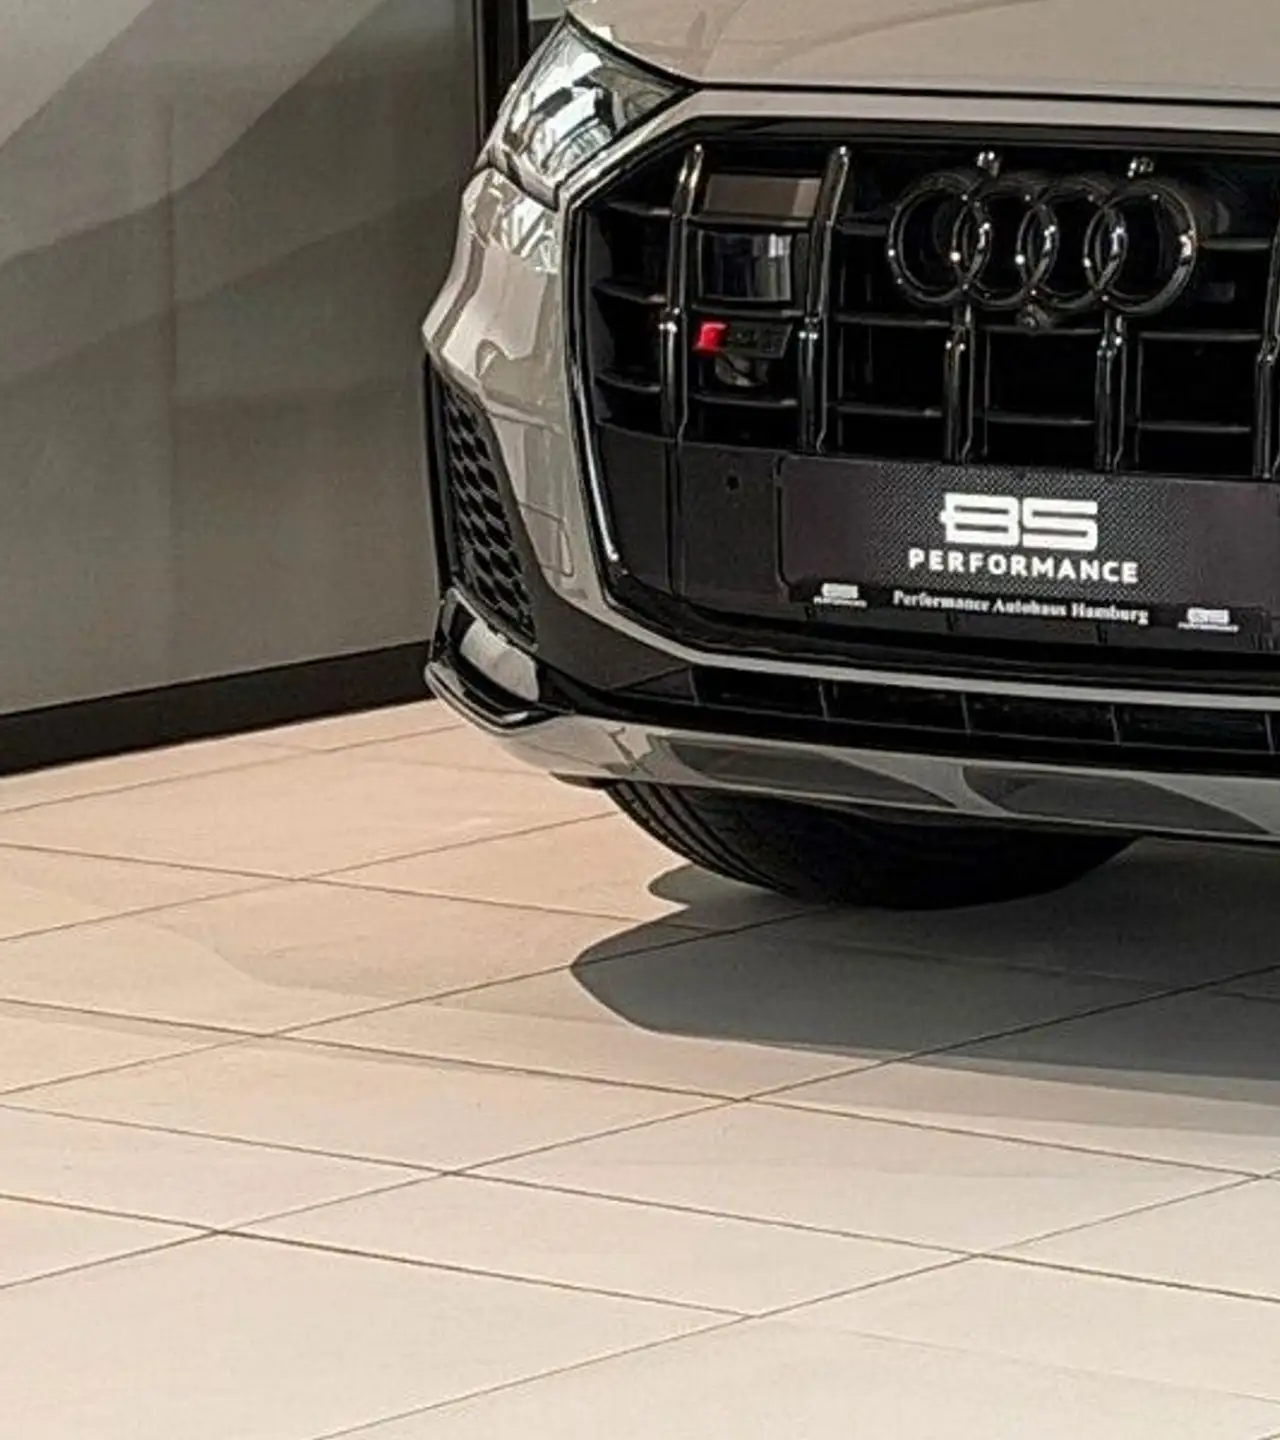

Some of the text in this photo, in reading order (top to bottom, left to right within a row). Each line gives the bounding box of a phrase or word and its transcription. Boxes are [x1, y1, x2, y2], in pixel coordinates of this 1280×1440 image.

[940, 492, 1099, 552] BS
[908, 548, 1139, 584] PERFORMANCE
[892, 590, 990, 613] Performance
[992, 598, 1067, 618] Autohaus
[1071, 602, 1150, 626] Hamburg
